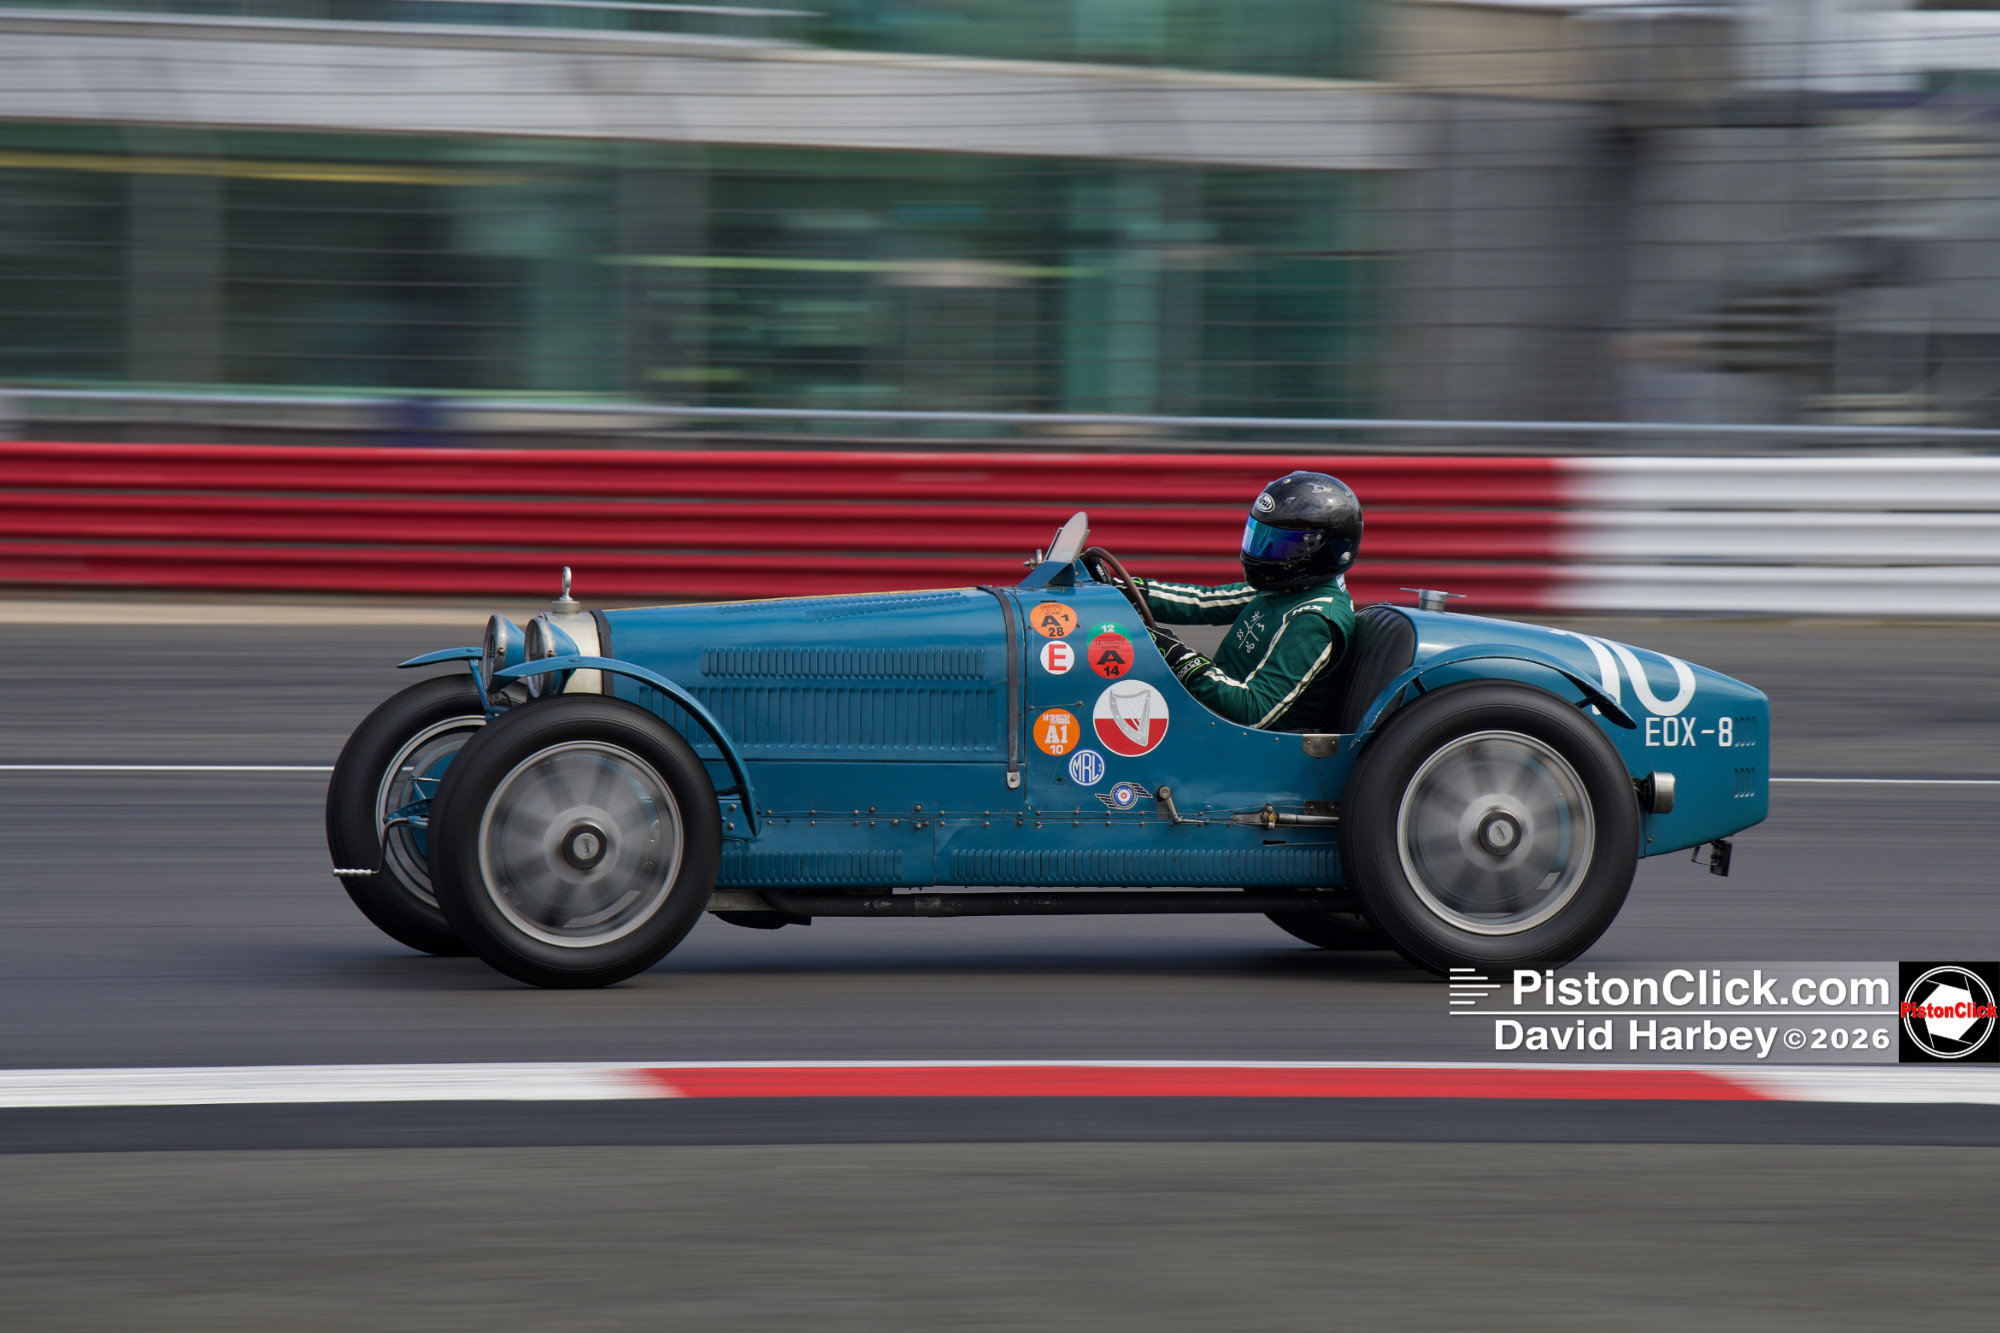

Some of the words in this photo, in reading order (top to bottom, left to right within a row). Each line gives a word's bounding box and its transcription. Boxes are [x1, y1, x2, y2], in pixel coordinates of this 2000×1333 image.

[1049, 627, 1064, 637] 28
[1101, 624, 1115, 633] 12
[1049, 644, 1067, 670] E
[1097, 650, 1126, 665] A
[1104, 666, 1120, 676] 14
[1044, 725, 1068, 744] A1
[1049, 745, 1064, 754] 10
[1072, 753, 1100, 782] MRL
